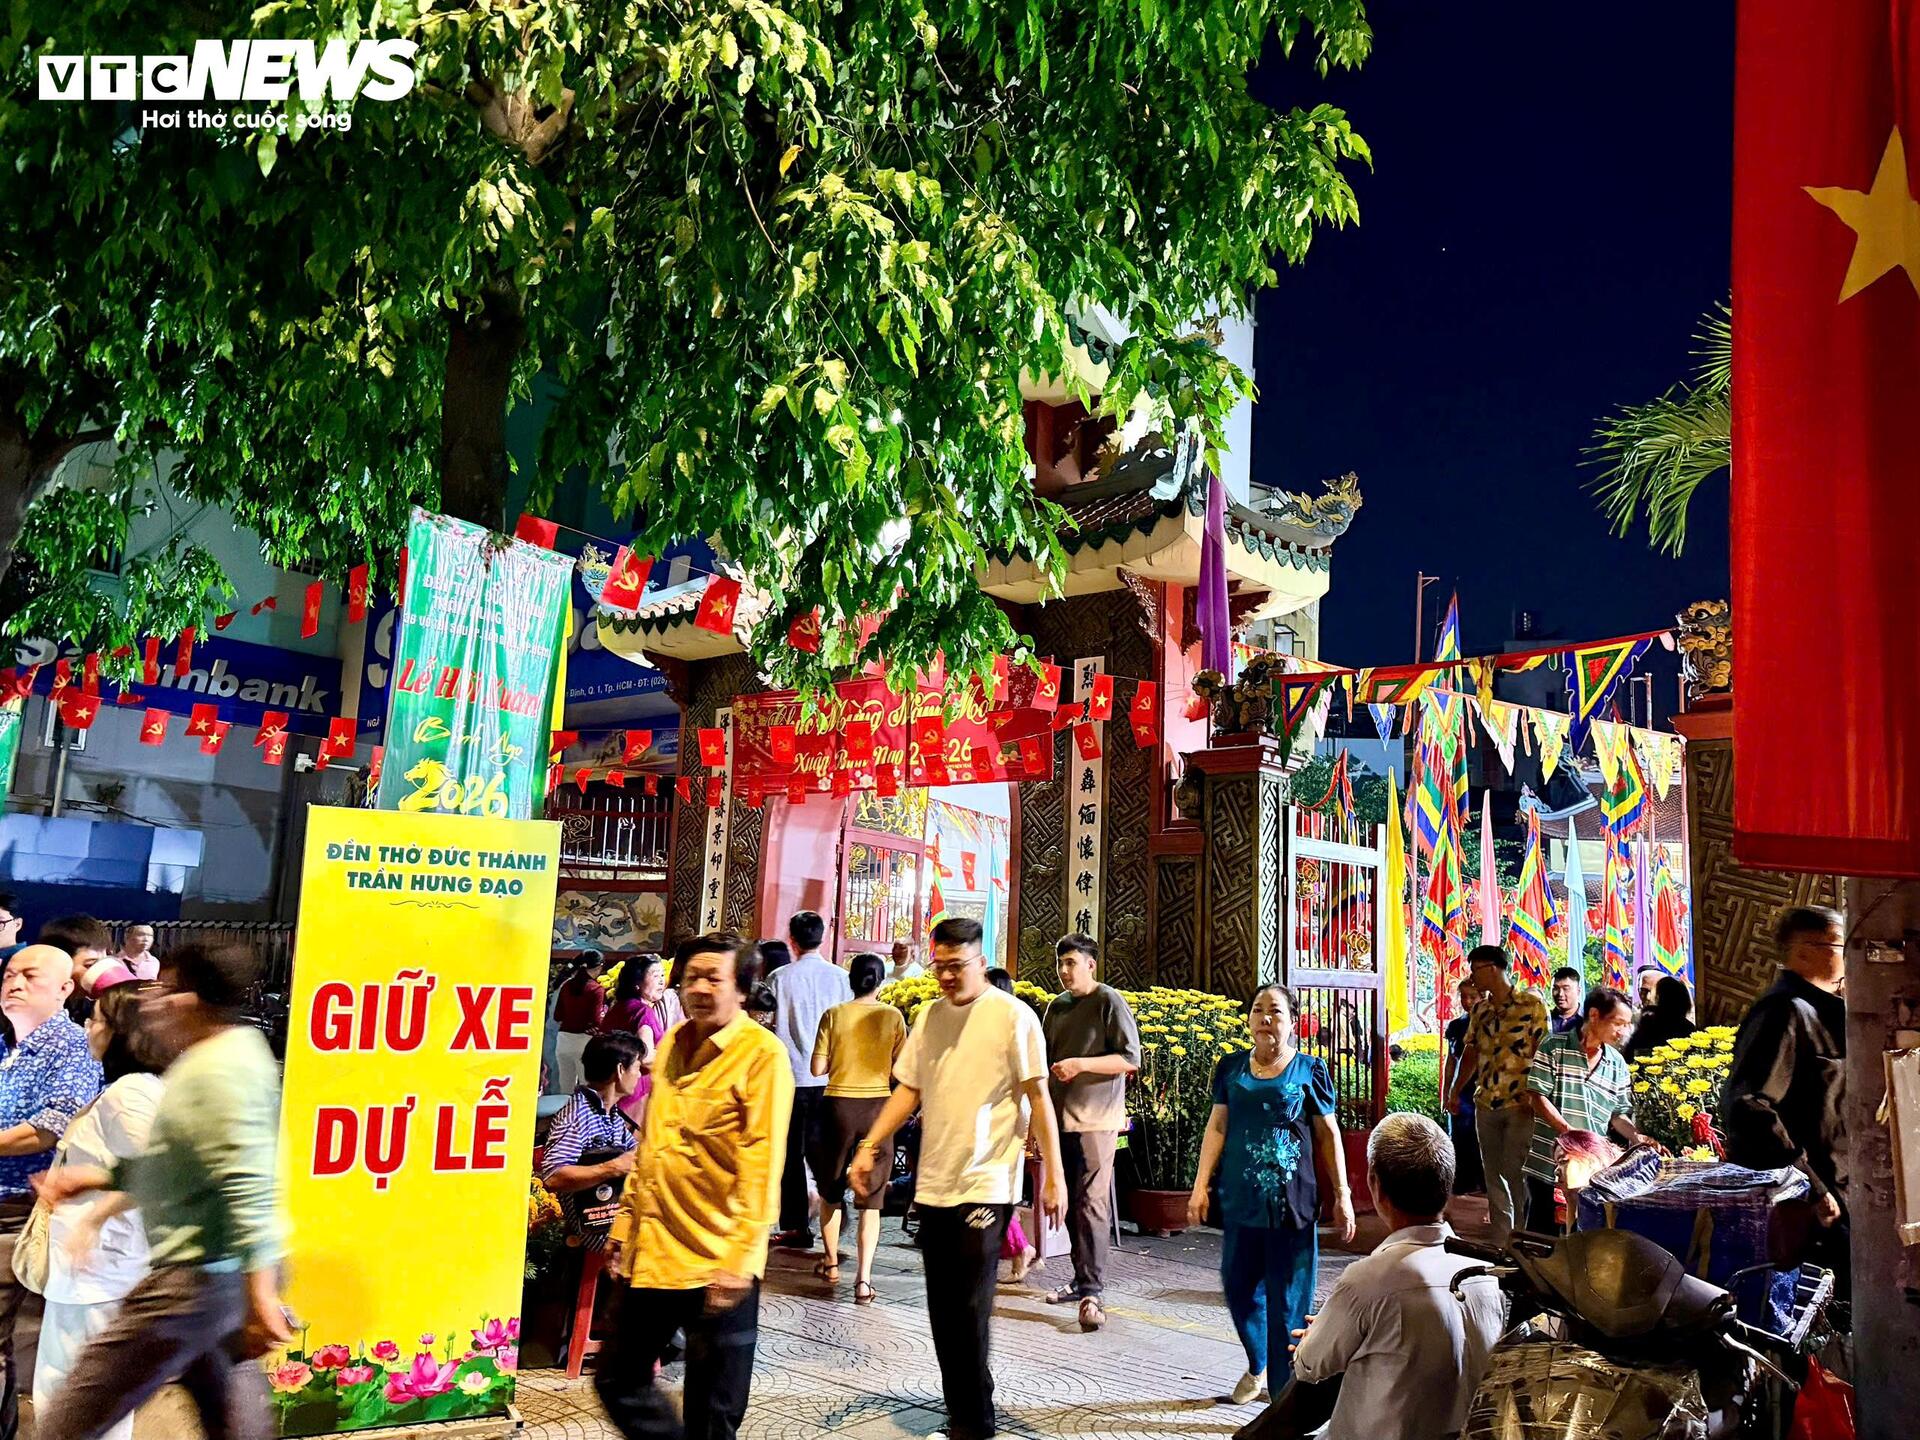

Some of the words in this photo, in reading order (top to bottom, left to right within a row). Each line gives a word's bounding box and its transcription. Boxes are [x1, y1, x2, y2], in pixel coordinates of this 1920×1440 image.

[326, 839, 371, 861] ĐỀN
[378, 843, 422, 864] THỜ
[428, 846, 471, 867] ĐỨC
[477, 850, 547, 870] THÁNH
[347, 868, 403, 889] TRẦN
[410, 874, 473, 893] HƯNG
[479, 878, 524, 898] ĐẠO
[310, 969, 437, 1052] GIỮ
[449, 985, 534, 1050] XE
[312, 1096, 417, 1190] DỰ
[434, 1077, 511, 1171] LỄ
